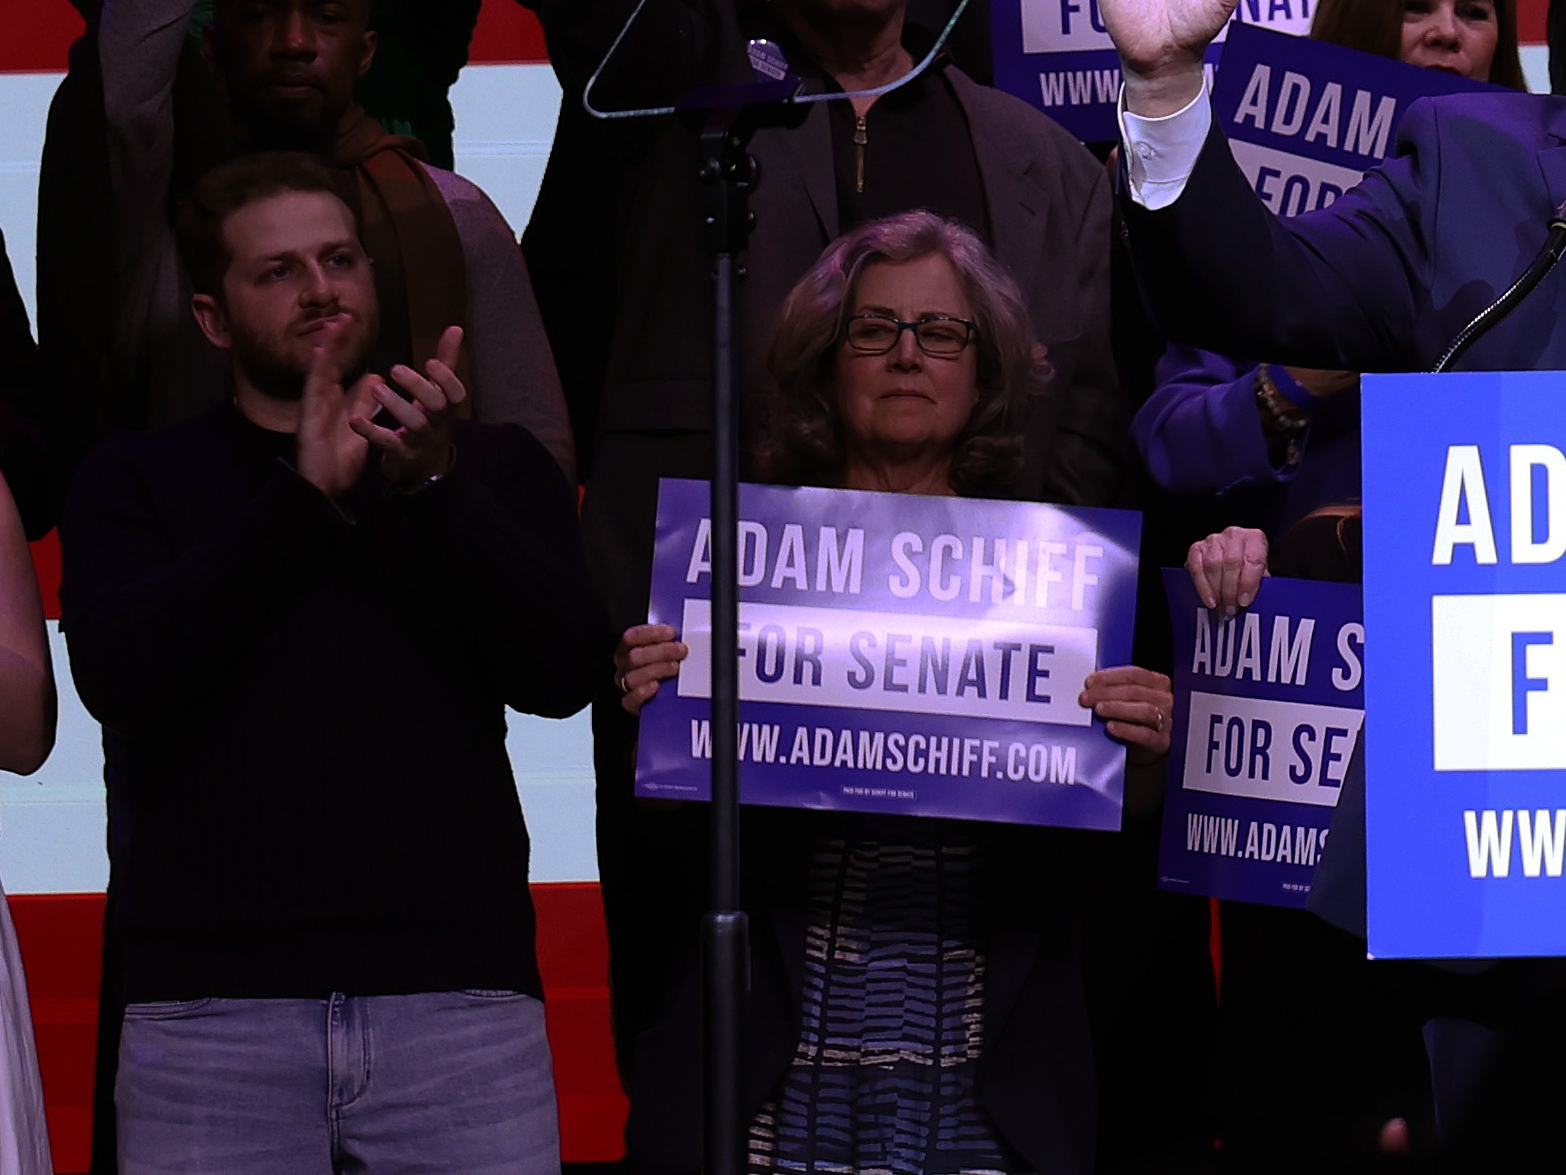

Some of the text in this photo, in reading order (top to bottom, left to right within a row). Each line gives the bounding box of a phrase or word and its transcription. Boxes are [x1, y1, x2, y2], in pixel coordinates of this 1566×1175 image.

[1233, 63, 1397, 159] ADAM
[686, 518, 1104, 611] ADAM SCHIFF
[847, 630, 1056, 704] SENATE
[1192, 607, 1315, 686] ADAM
[1205, 714, 1272, 781] FOR
